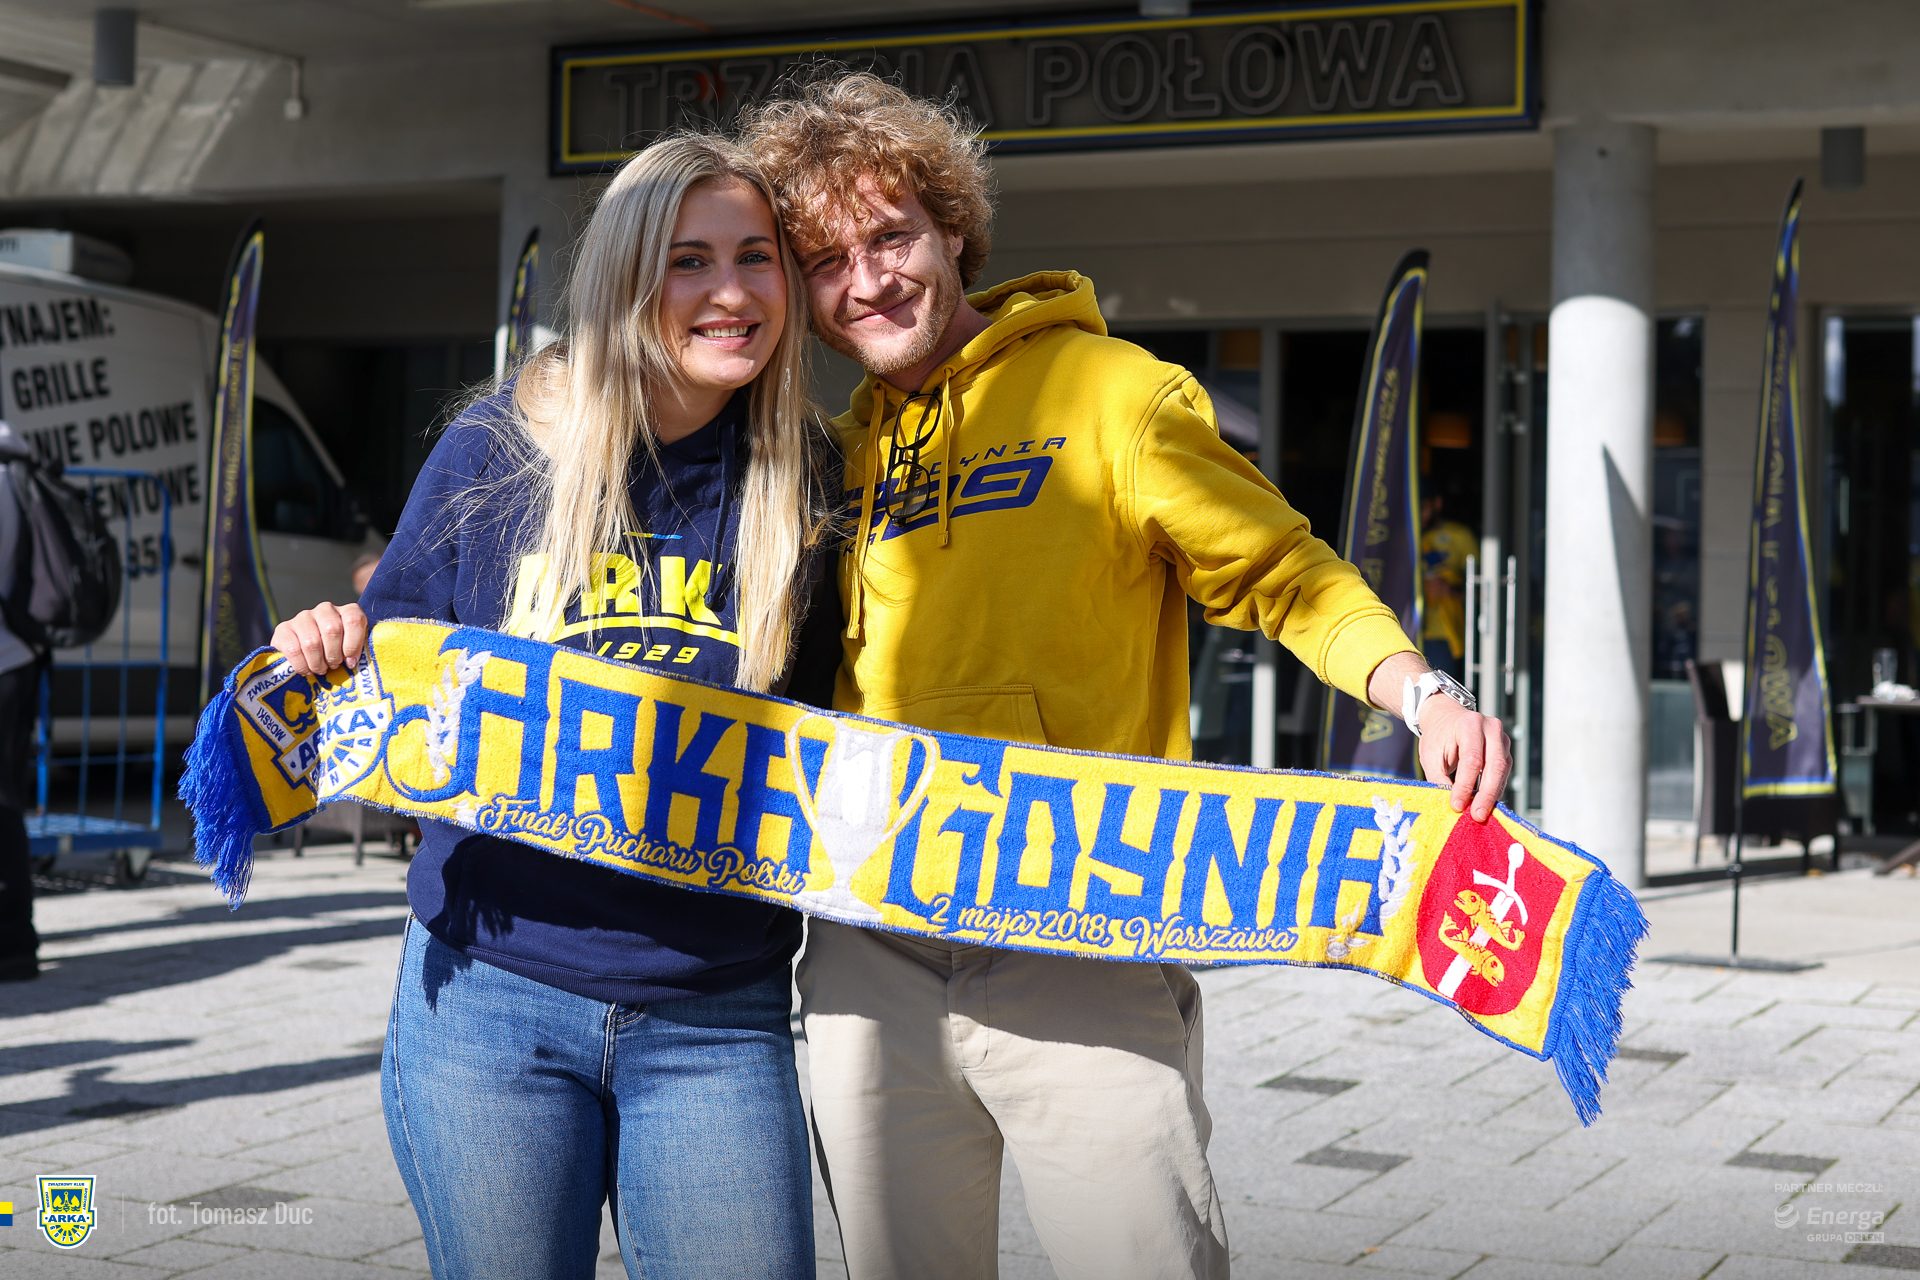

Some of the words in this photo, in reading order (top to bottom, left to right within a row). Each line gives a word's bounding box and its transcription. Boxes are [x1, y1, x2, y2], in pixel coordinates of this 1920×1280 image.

[604, 45, 992, 148] TRZIA
[1026, 14, 1465, 127] POŁOWA
[11, 357, 111, 412] GRILLE
[88, 401, 198, 459] POLOWE
[95, 464, 200, 519] ENTOWE
[508, 553, 723, 643] ARK
[597, 641, 700, 664] 1929
[256, 706, 287, 742] MORSKI
[299, 709, 377, 770] ARKA
[575, 816, 700, 870] Pucharu
[706, 849, 805, 891] Polski
[881, 731, 1422, 937] GDYNIA
[930, 896, 951, 923] 2
[957, 905, 1036, 945] maja
[1040, 909, 1114, 946] 2018,
[1124, 917, 1298, 956] Warszawa
